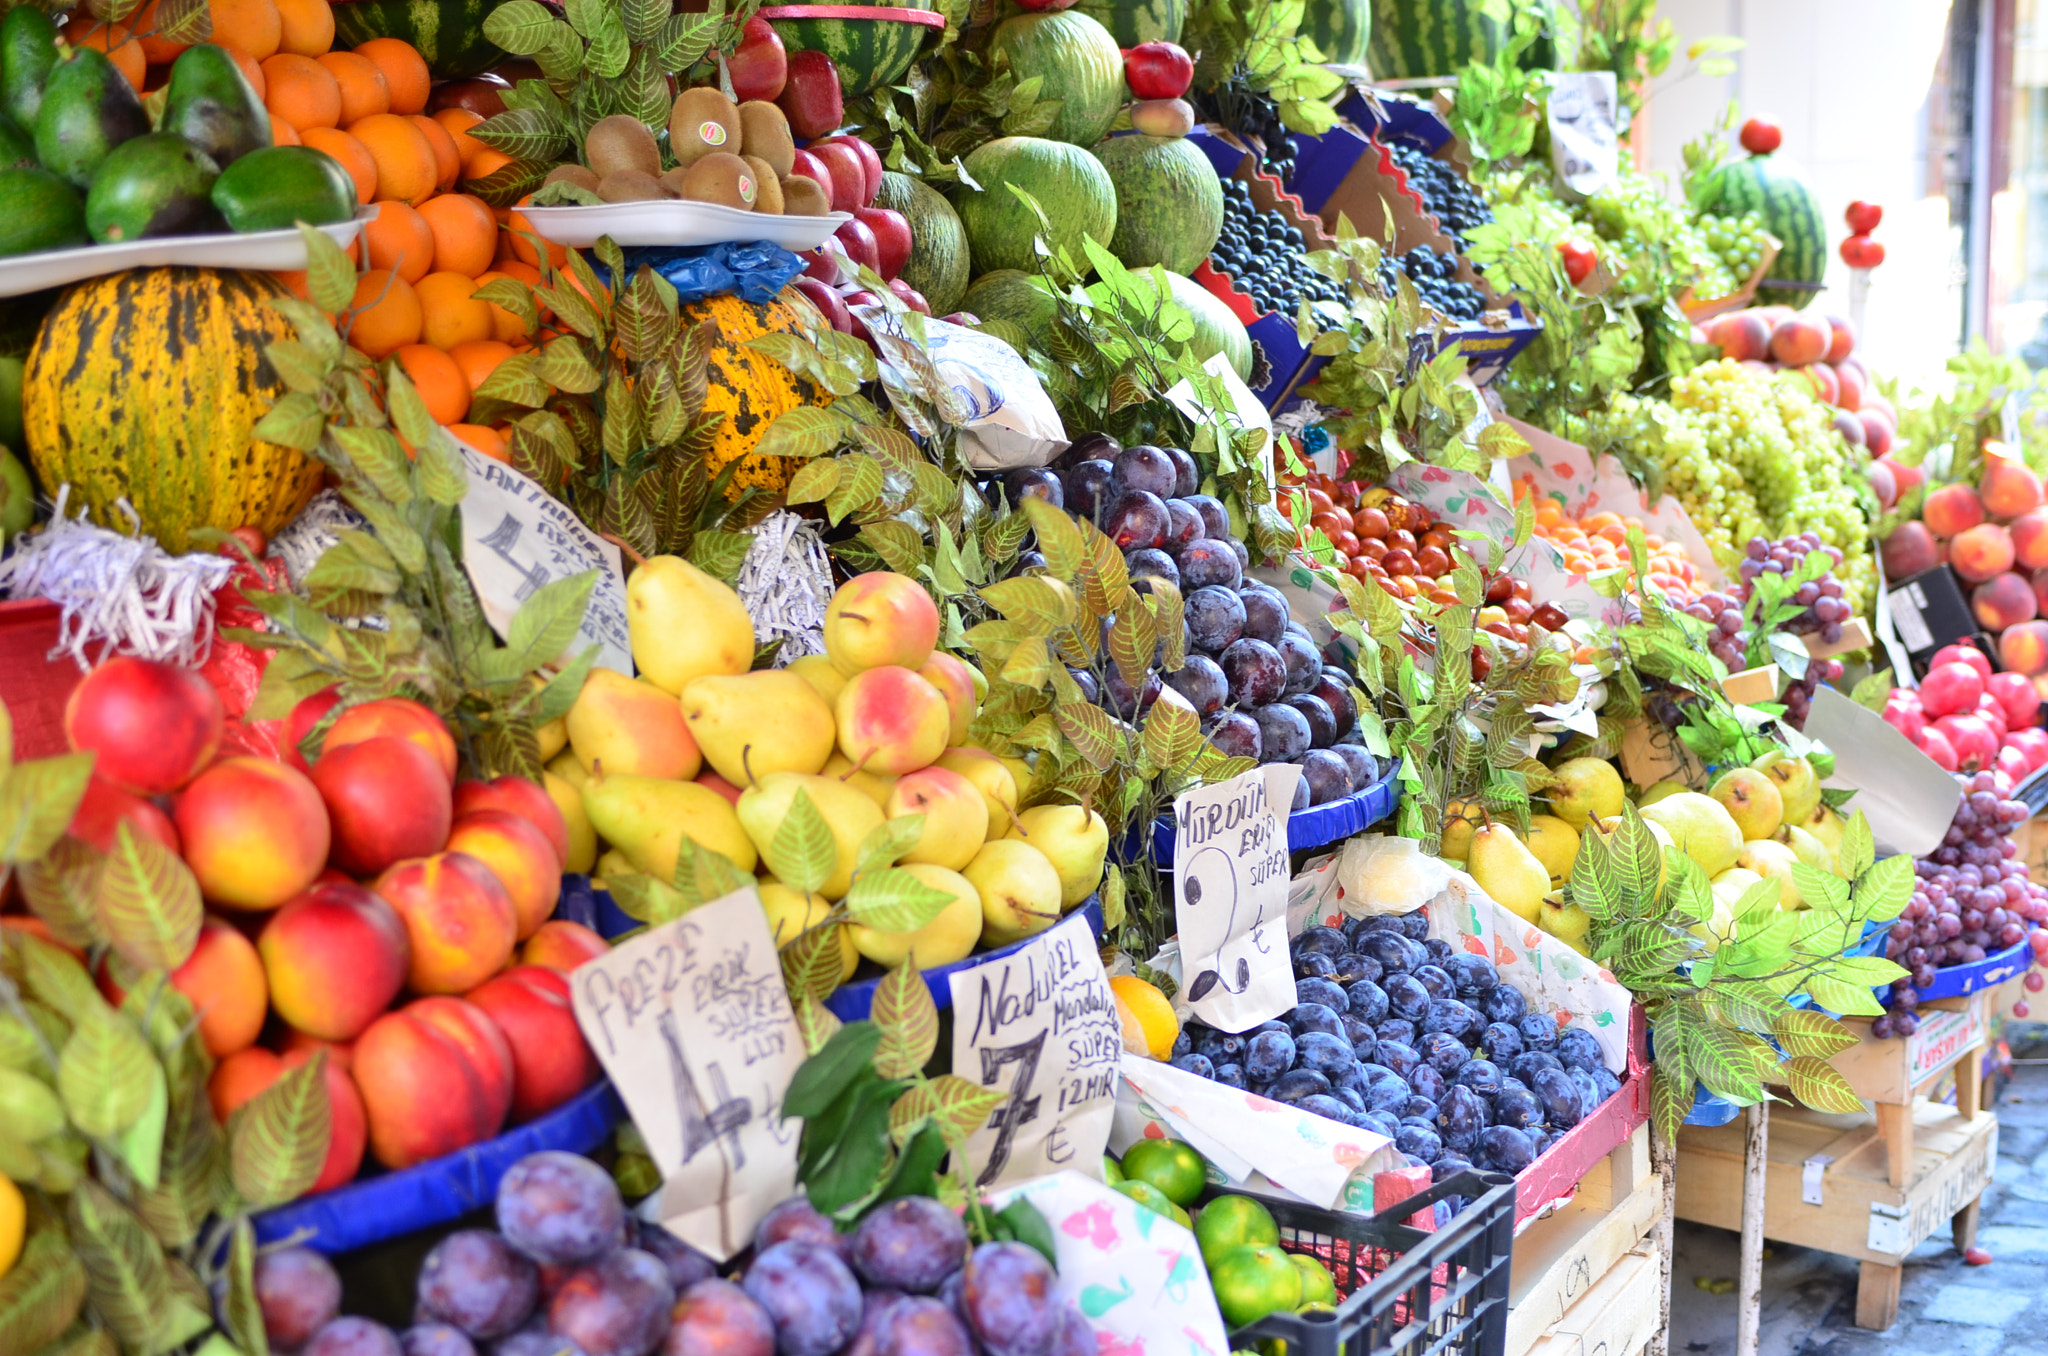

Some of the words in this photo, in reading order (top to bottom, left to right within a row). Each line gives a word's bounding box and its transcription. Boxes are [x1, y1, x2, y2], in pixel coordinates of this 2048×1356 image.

[477, 511, 551, 600] 4
[1177, 777, 1267, 860] MÜRDÜM
[656, 1007, 752, 1173] 4
[974, 1028, 1049, 1188] 7
